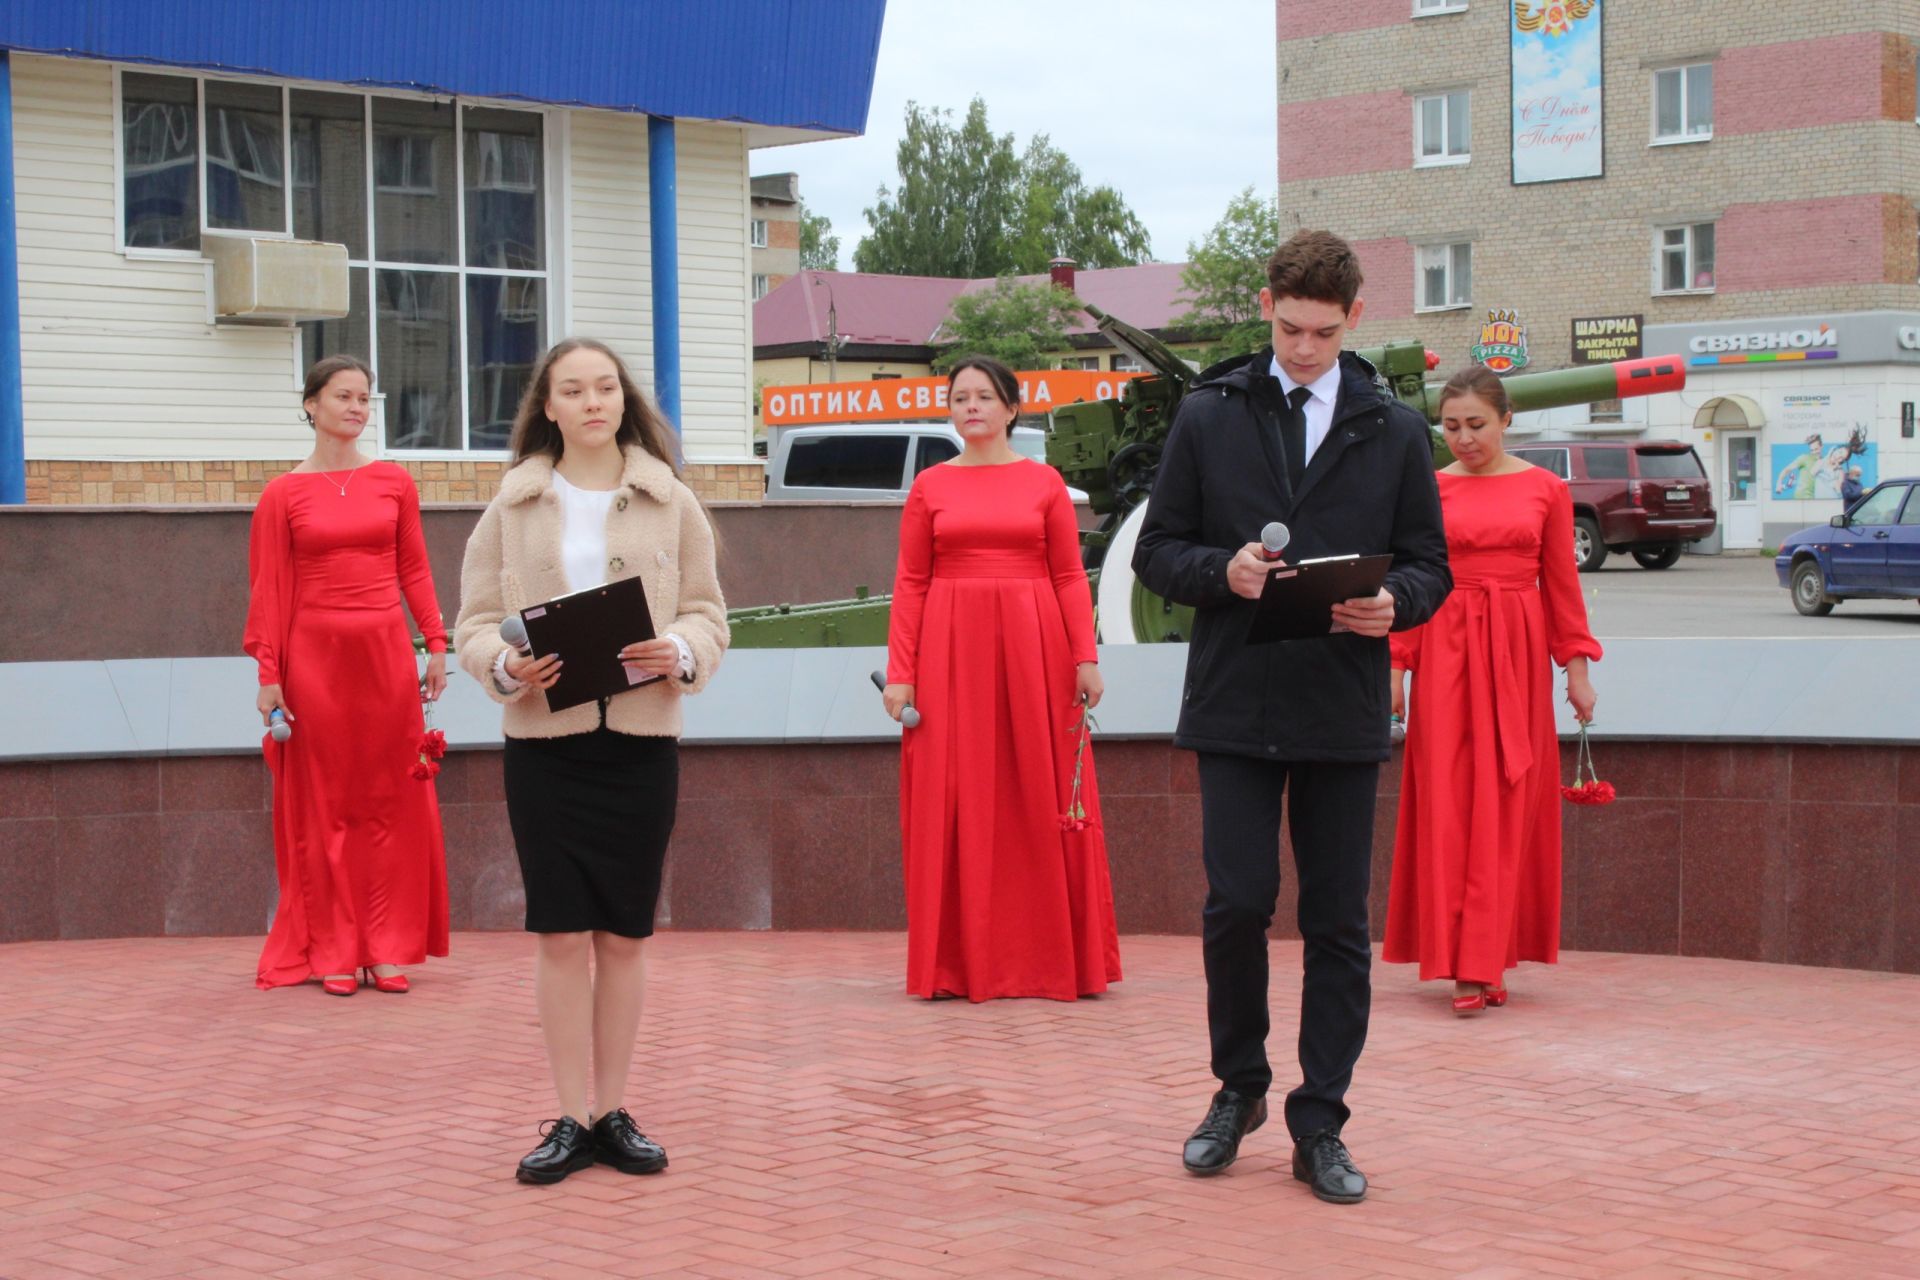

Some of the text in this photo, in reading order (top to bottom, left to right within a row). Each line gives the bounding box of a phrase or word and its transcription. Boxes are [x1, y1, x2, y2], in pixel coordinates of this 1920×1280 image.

[1481, 324, 1521, 345] HOT
[1576, 318, 1637, 336] ШАУРМА
[1577, 336, 1638, 349] ЗАКРЫТАЯ
[1690, 323, 1837, 353] СВЯЗНОЙ
[1480, 346, 1519, 357] PIZZA
[1587, 348, 1627, 360] ПИЦЦА
[770, 389, 884, 417] ОПТИКА
[896, 380, 1052, 408] СВЕНА
